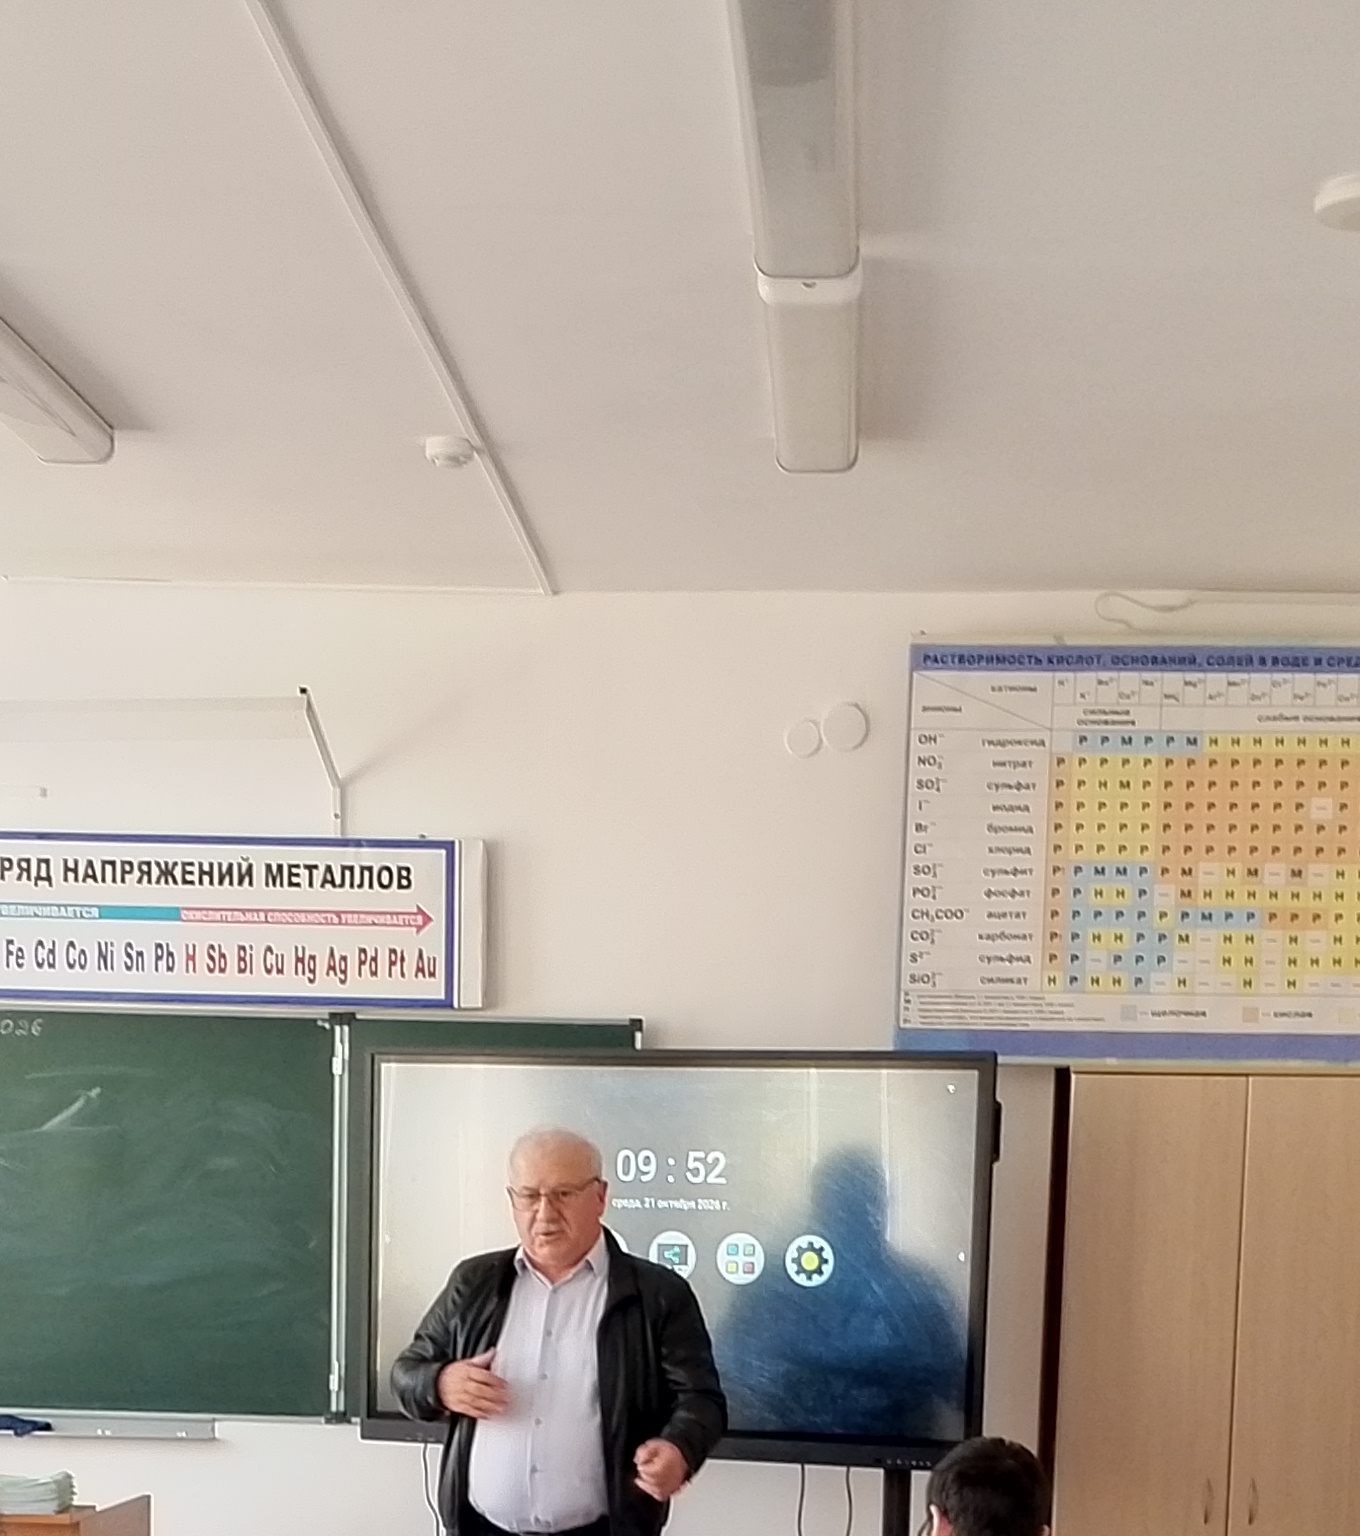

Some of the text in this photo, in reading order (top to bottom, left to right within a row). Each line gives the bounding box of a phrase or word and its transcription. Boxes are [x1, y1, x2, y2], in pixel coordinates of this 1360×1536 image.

[922, 654, 1043, 667] РАСТВОРИМОСТЬ
[1206, 654, 1254, 667] СОЛЕЙ
[1271, 656, 1310, 668] ВОДЕ
[0, 856, 54, 888] РЯД
[62, 856, 254, 888] НАПРЯЖЕНИЙ
[264, 862, 413, 890] МЕТАЛЛОВ
[267, 911, 339, 924] СПОСОБНОСТЬ
[6, 939, 24, 968] Fe
[34, 940, 56, 969] Cd
[66, 940, 87, 970] Co
[97, 941, 115, 971] Ni
[124, 942, 145, 972] Sn
[154, 943, 175, 974] Pb
[185, 944, 195, 974] H
[207, 944, 227, 973] Sb
[237, 945, 253, 975] Bi
[263, 946, 284, 975] Cu
[295, 946, 316, 984] Hg
[326, 947, 347, 985] Ag
[358, 948, 378, 978] Pd
[388, 948, 405, 979] Pt
[415, 948, 436, 979] Au
